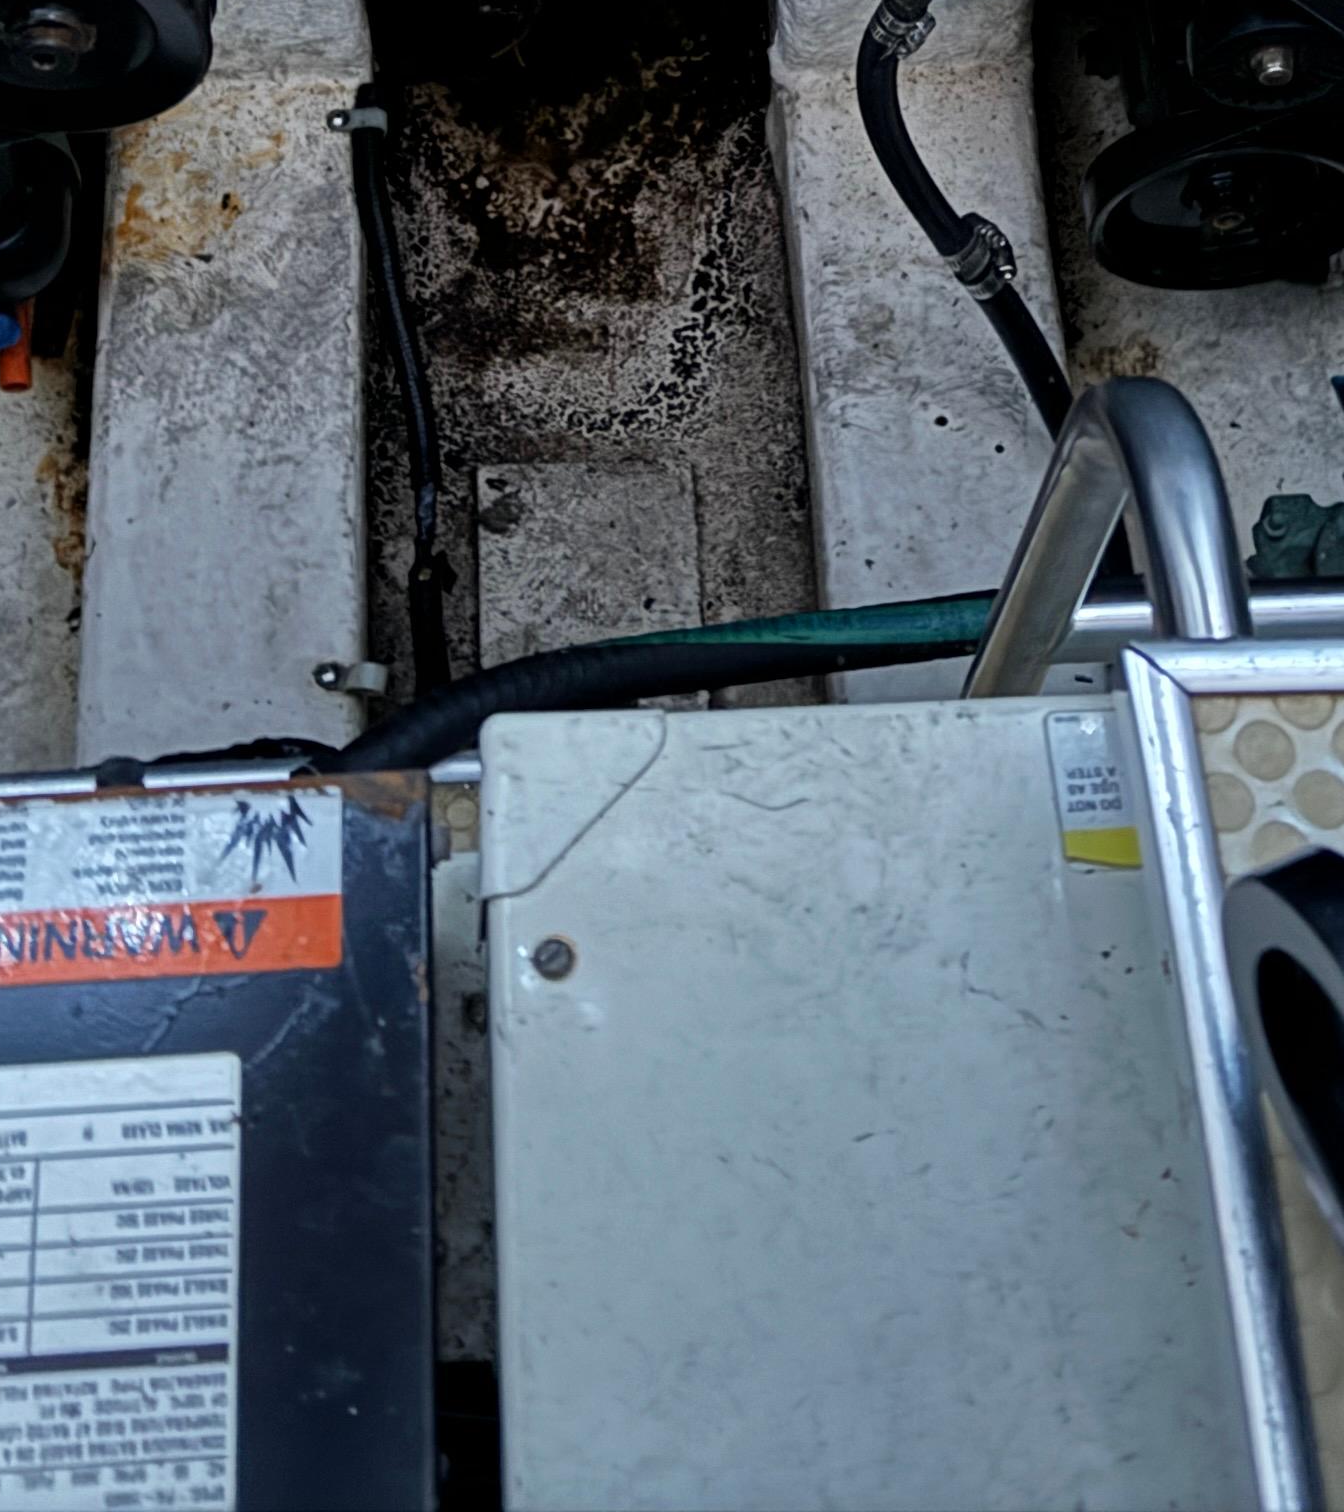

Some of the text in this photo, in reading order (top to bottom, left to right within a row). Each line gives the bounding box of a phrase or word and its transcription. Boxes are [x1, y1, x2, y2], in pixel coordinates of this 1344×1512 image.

[1065, 766, 1116, 779] A STEP
[1068, 782, 1120, 796] USE AS
[1067, 798, 1122, 813] DO NOT
[143, 1211, 185, 1226] PHASE
[189, 1208, 229, 1223] THREE
[142, 1247, 184, 1262] PHASE
[189, 1244, 229, 1259] THREE
[137, 1282, 179, 1298] PHASE
[184, 1278, 228, 1295] SINGLE
[136, 1318, 179, 1334] PHASE
[184, 1314, 228, 1331] SINGLE
